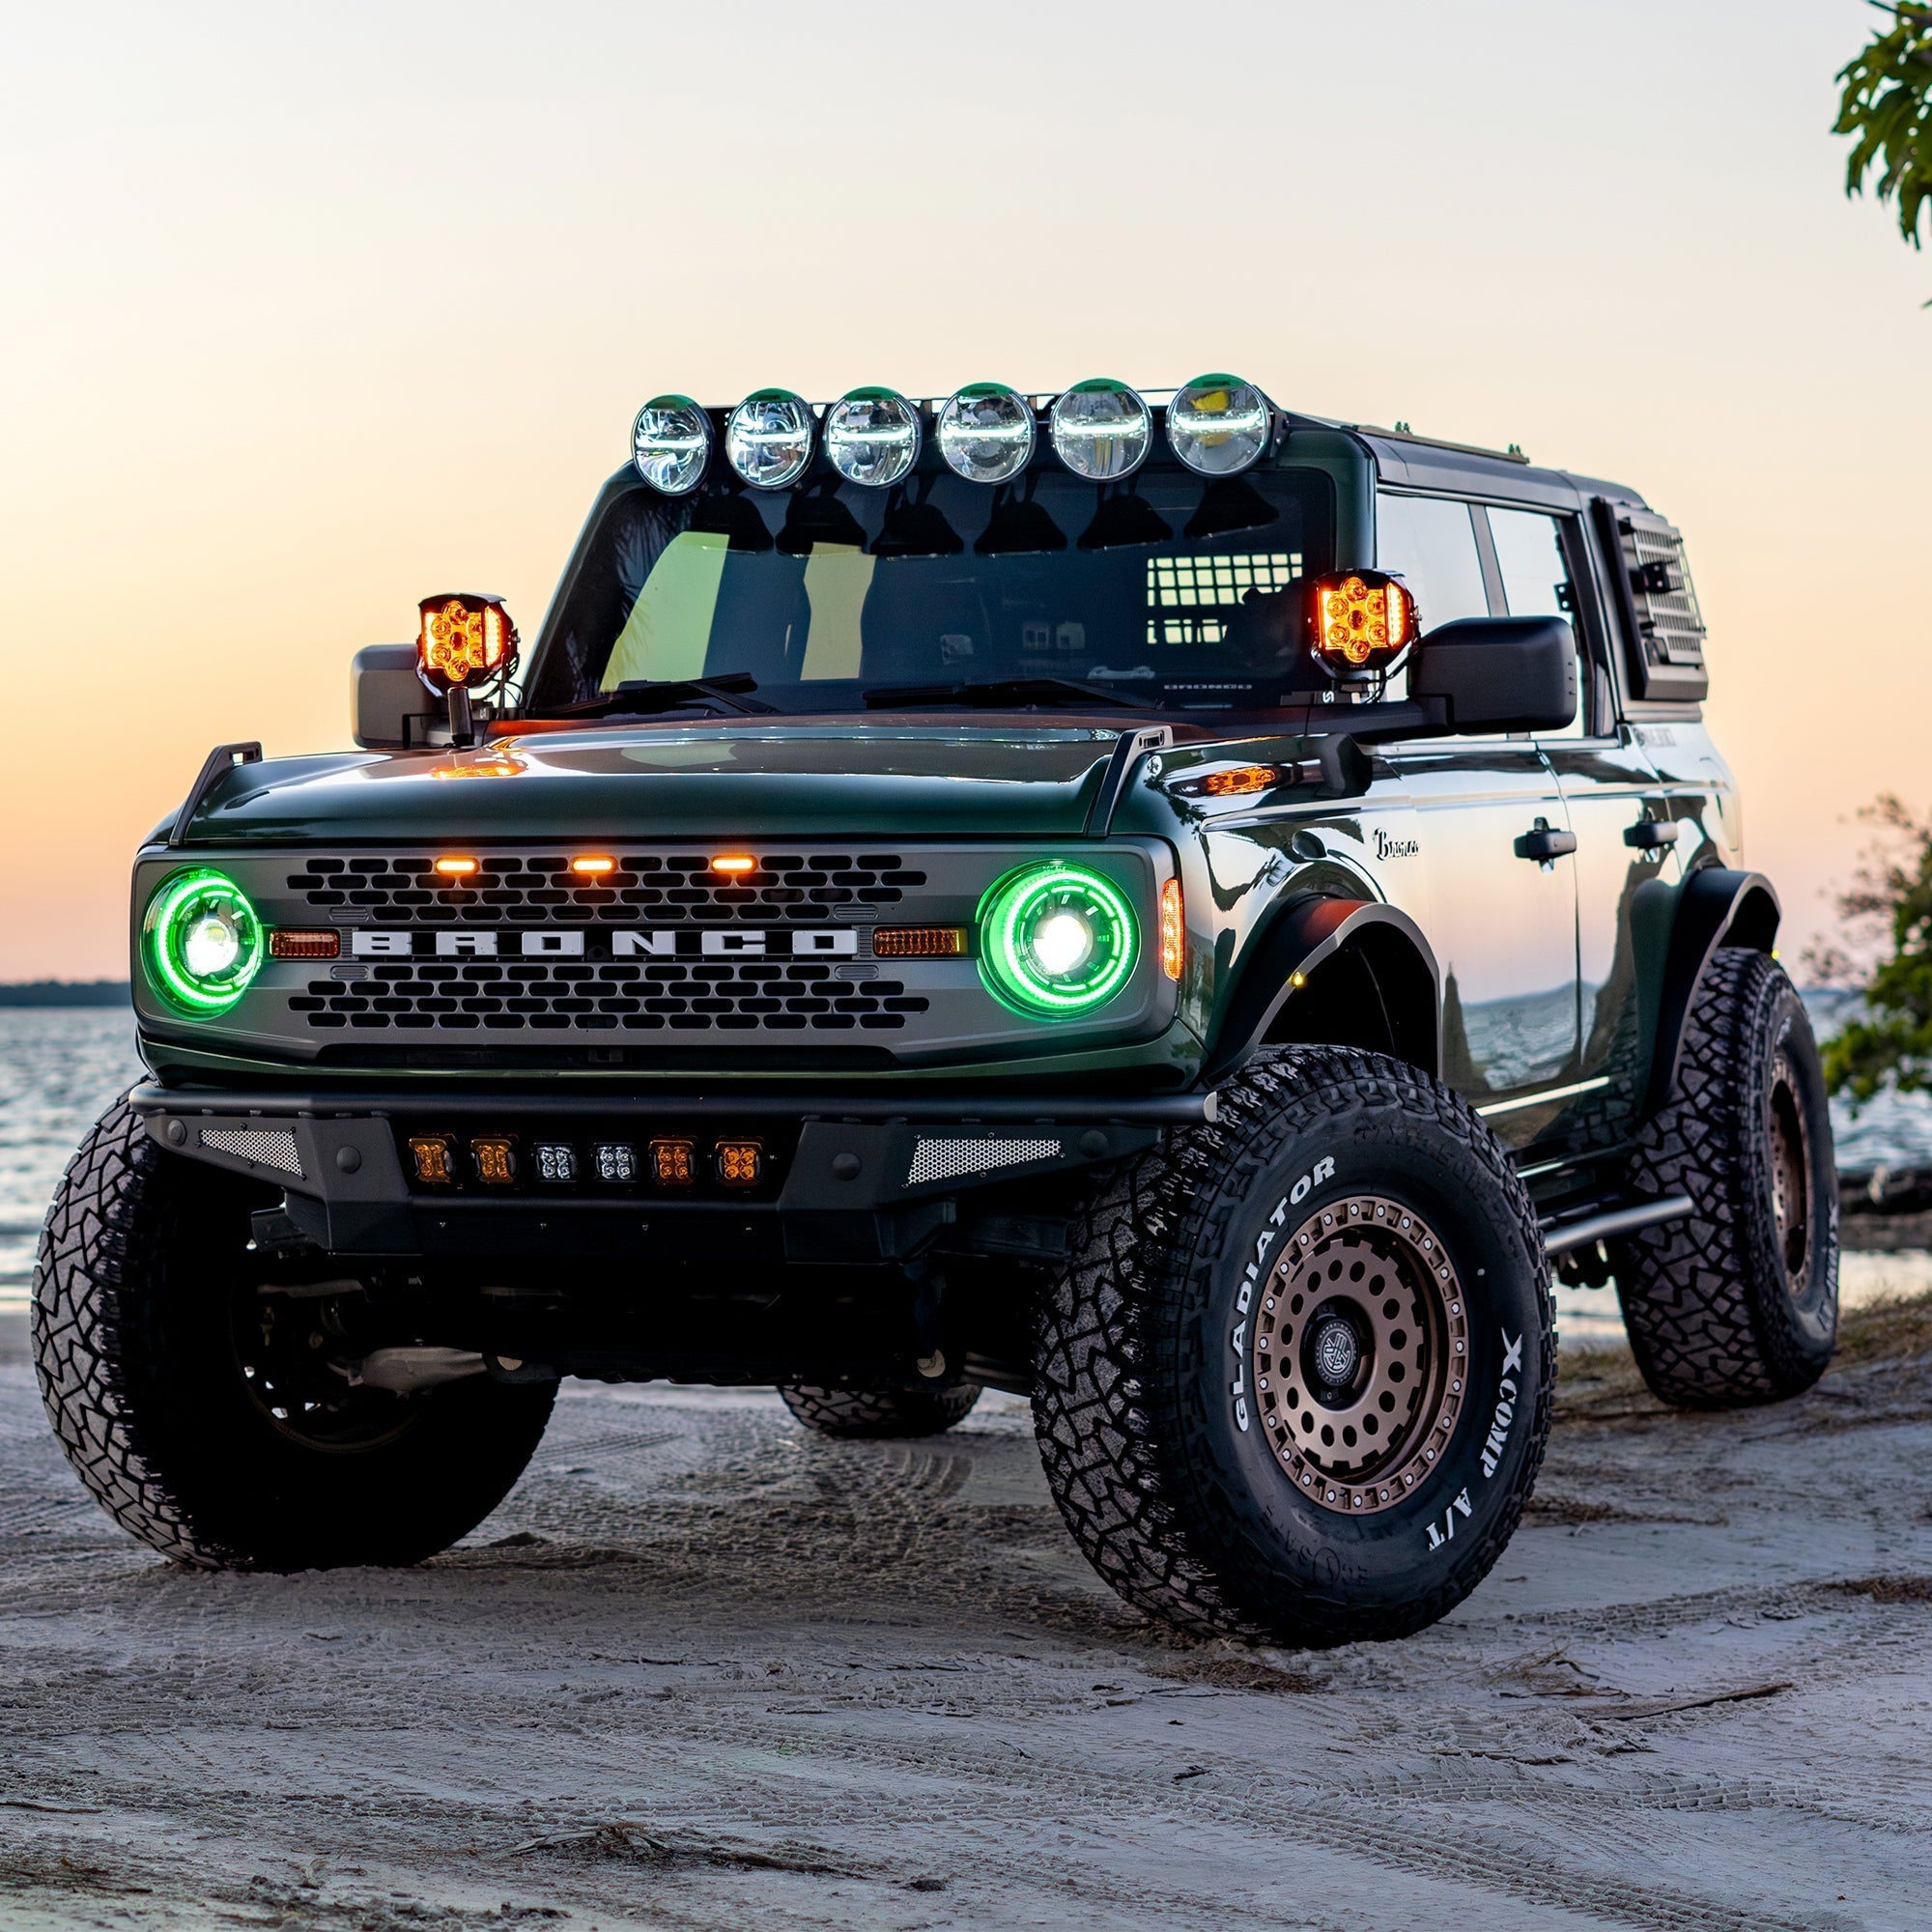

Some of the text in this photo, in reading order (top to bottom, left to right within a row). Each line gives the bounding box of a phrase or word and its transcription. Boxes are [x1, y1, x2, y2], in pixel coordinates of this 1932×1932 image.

[352, 930, 859, 955] BRONCO
[1231, 1155, 1335, 1432] GLADIATOR
[1426, 1326, 1522, 1551] X COMP A/T
